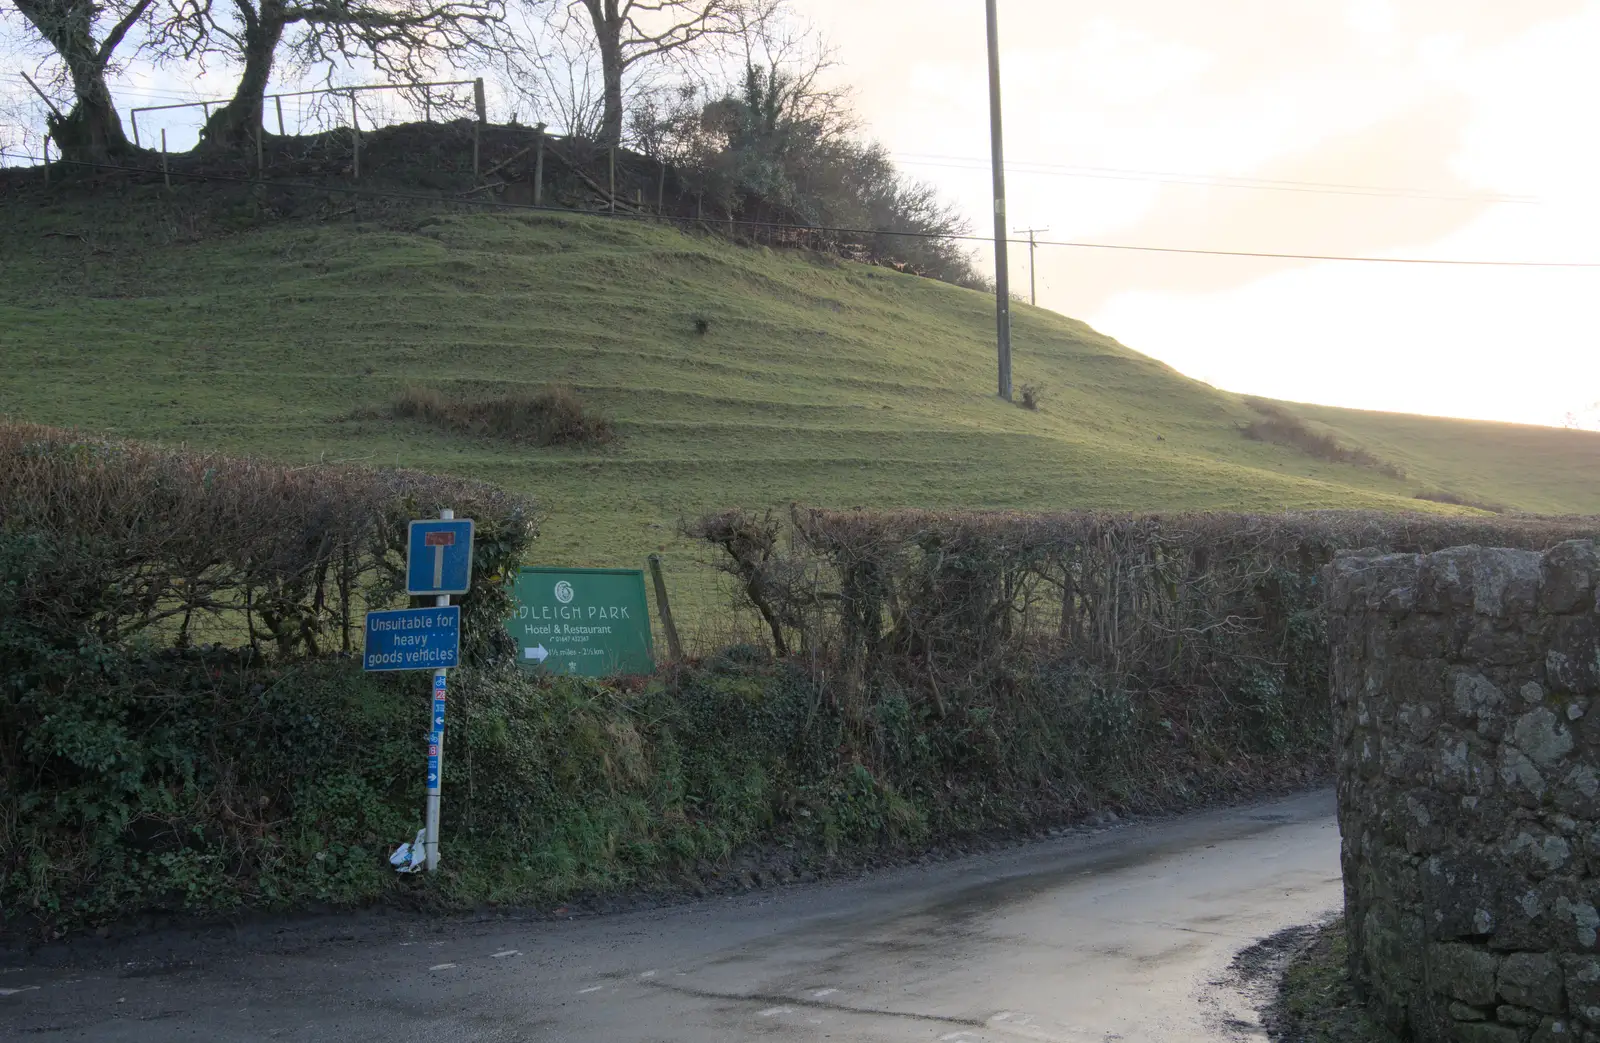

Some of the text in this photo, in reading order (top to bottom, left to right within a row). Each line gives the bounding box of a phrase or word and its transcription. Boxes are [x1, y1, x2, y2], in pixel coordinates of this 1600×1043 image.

[513, 606, 630, 619] IDLEIGH PARK
[370, 614, 454, 632] Unsuitable for
[525, 623, 612, 634] Hotel & Restaurant
[393, 633, 428, 648] heavy
[368, 647, 454, 667] goods vehicles
[559, 648, 577, 656] miles
[593, 647, 604, 655] km
